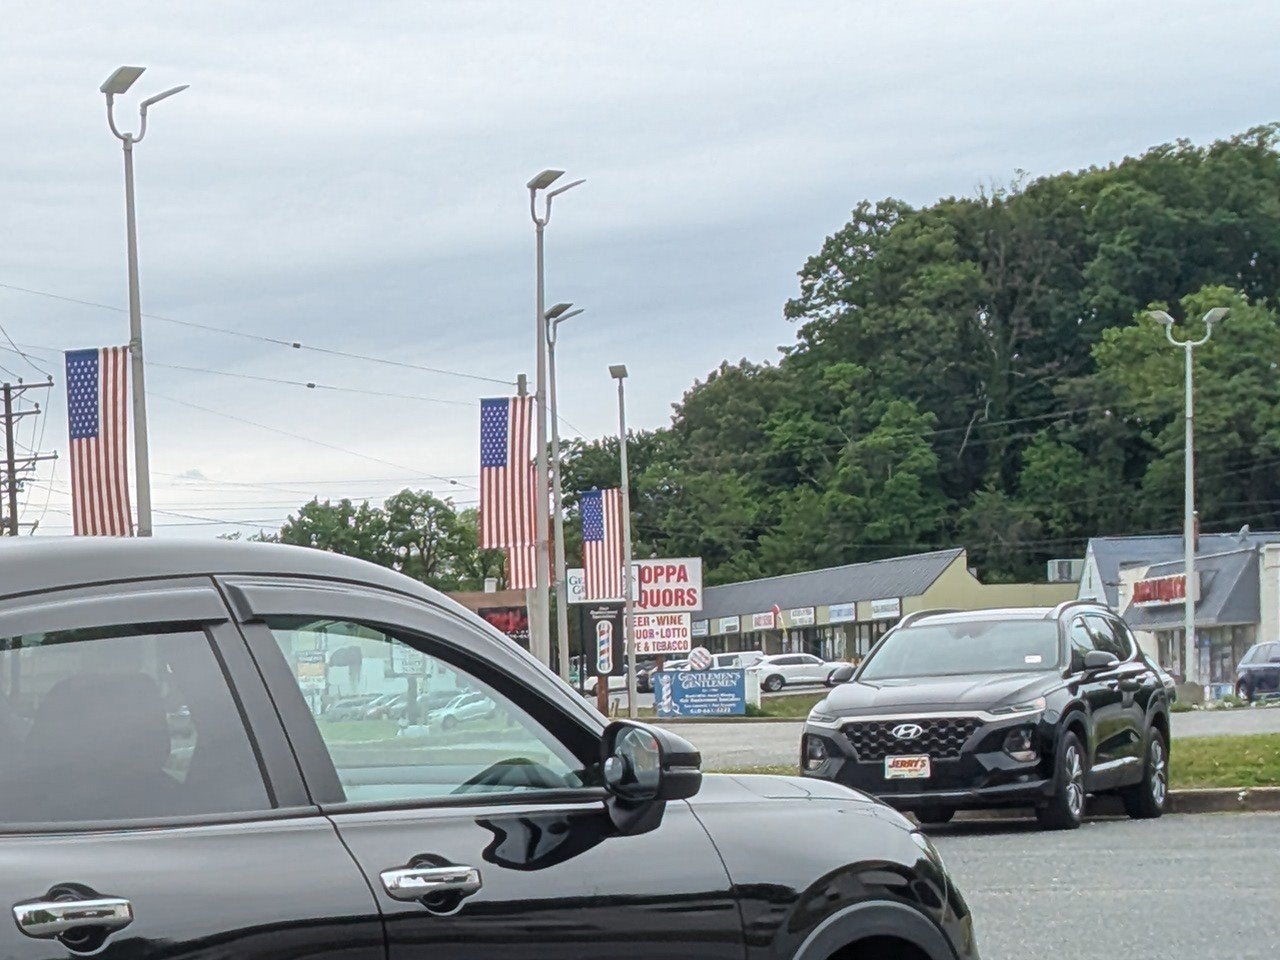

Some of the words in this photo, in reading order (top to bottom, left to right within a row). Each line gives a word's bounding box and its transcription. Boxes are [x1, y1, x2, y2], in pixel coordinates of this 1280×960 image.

[640, 565, 688, 584] OPPA
[637, 588, 698, 609] QUORS
[656, 614, 683, 626] WINE
[660, 627, 688, 639] LOTTO
